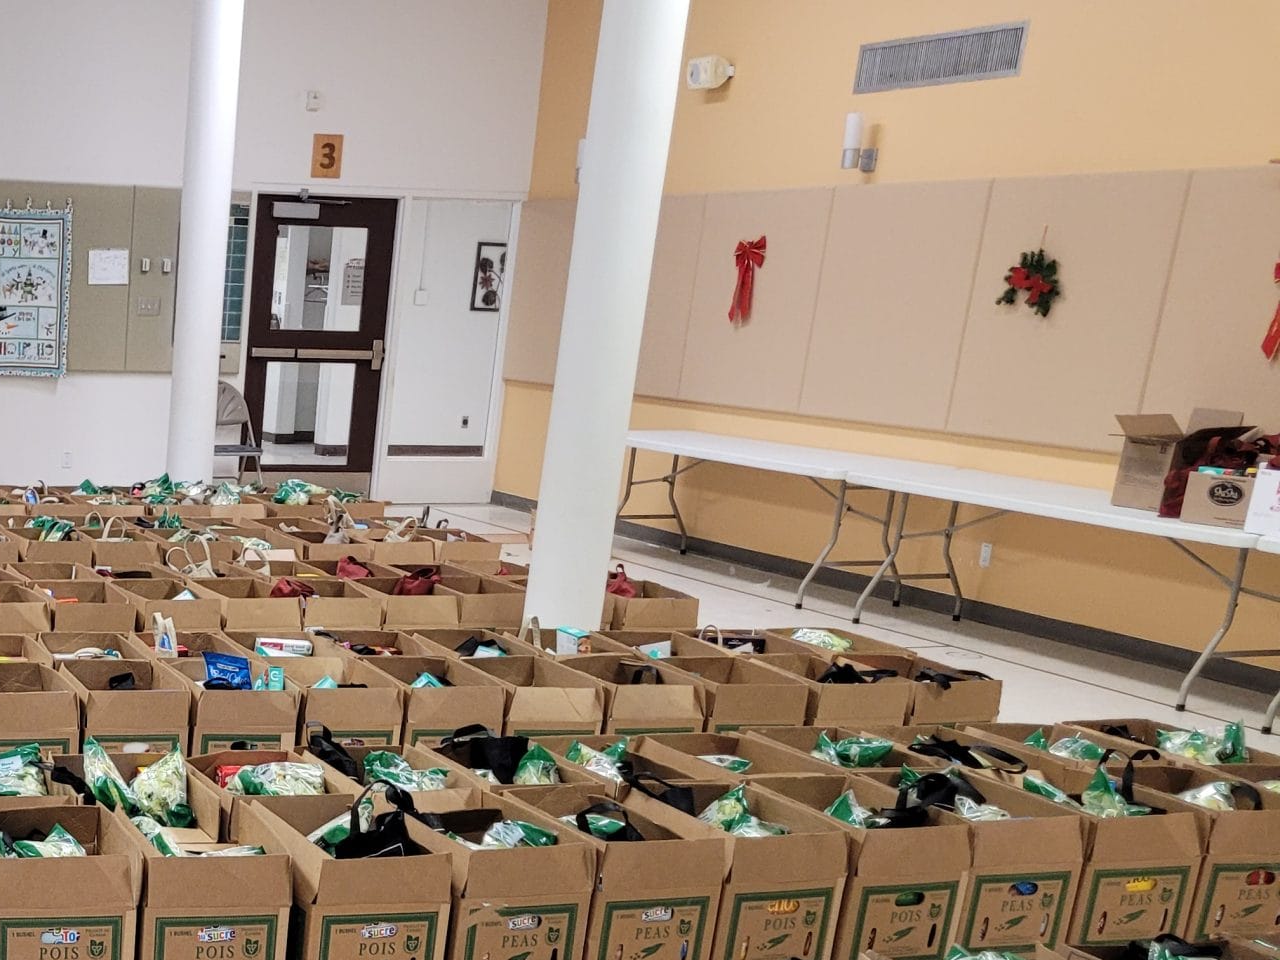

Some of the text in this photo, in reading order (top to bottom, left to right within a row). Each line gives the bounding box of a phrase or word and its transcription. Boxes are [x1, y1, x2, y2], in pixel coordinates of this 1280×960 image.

[320, 143, 336, 168] 3
[1119, 893, 1153, 906] PEAS
[1238, 888, 1270, 900] PEAS
[1001, 899, 1034, 913] PEAS
[890, 909, 922, 924] POIS
[367, 925, 394, 937] sucre
[763, 917, 797, 931] POIS
[207, 929, 236, 941] sucre
[634, 925, 671, 940] PEAS
[501, 933, 538, 948] PEAS
[39, 946, 79, 960] POIS
[196, 945, 235, 960] POIS
[358, 942, 396, 956] POIS
